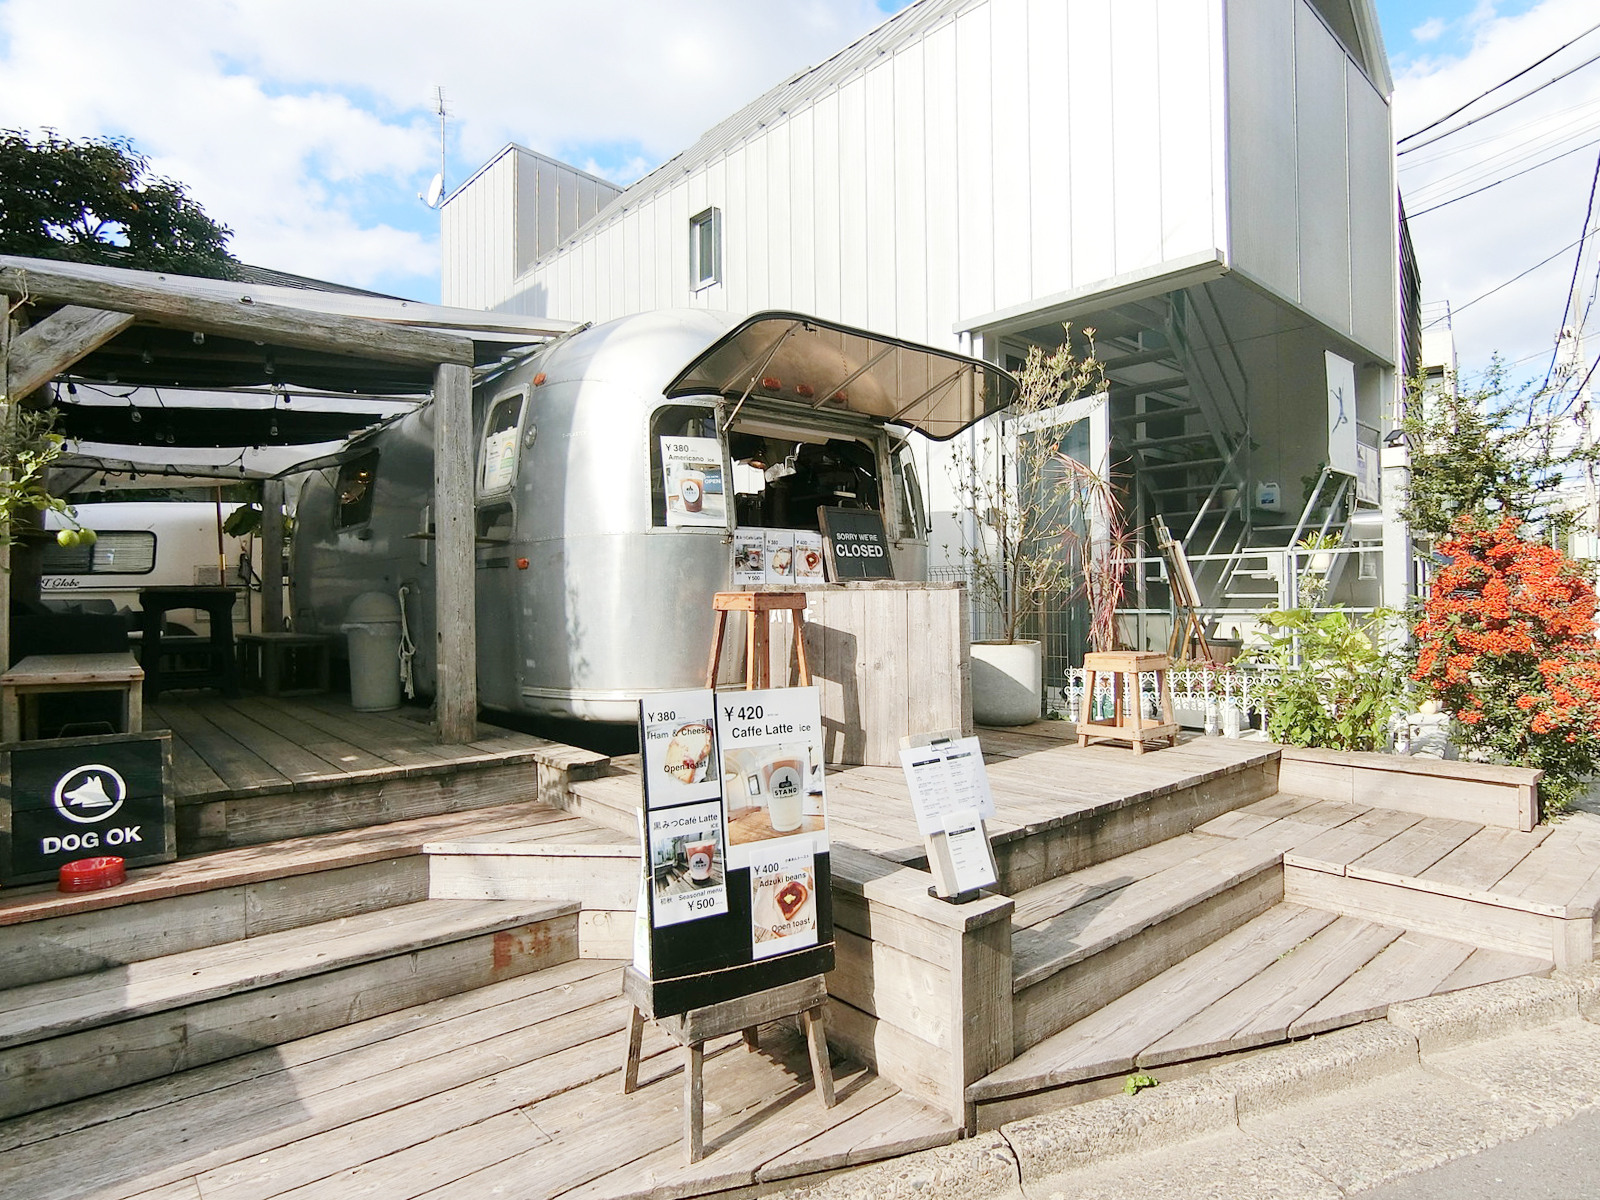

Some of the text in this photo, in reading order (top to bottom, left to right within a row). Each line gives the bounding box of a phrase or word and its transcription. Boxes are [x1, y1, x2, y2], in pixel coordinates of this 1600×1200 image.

[668, 454, 704, 462] Americano
[836, 532, 858, 540] SORRY
[836, 543, 884, 558] CLOSED
[650, 731, 669, 740] Ham
[672, 729, 678, 737] &
[731, 723, 811, 739] Caffe Latte ice
[663, 760, 707, 774] Open toast
[774, 786, 798, 796] STAND
[698, 813, 718, 823] Latte
[43, 826, 142, 854] DOG OK
[760, 872, 807, 888] Adzuki beans
[678, 889, 706, 901] Seasonal
[706, 887, 723, 895] menu
[771, 917, 811, 933] Open toast
